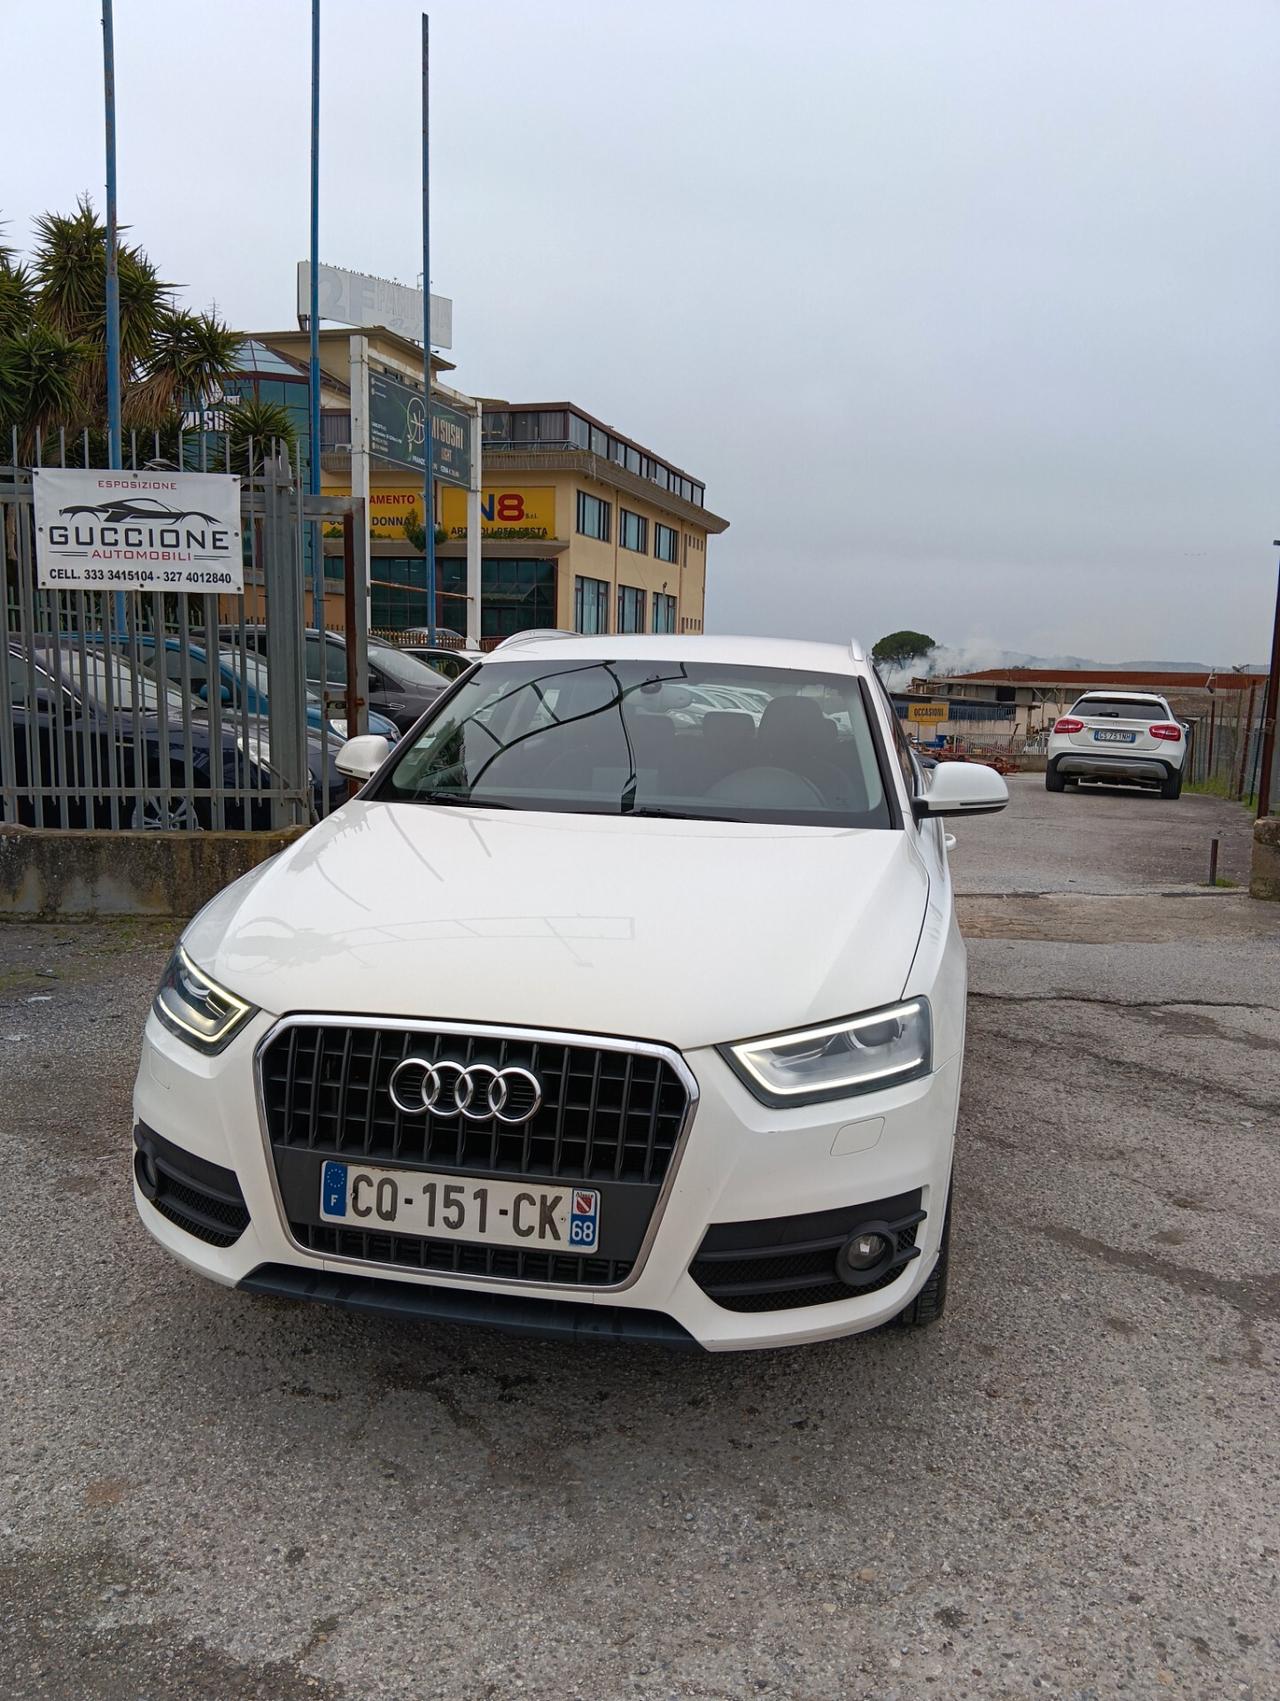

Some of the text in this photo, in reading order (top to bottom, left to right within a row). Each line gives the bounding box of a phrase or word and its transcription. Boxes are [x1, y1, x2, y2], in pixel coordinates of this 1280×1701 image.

[98, 480, 177, 491] ESPOSIZIONE
[49, 525, 229, 550] GUCCIONE
[92, 550, 191, 561] AUTOMOBILI
[49, 568, 81, 580] CELL.
[84, 569, 104, 580] 333
[108, 569, 154, 581] 3415104
[163, 571, 182, 582] 327
[186, 571, 232, 584] 4012840
[330, 1195, 339, 1207] F
[352, 1173, 563, 1241] CQ-151-CK
[571, 1220, 594, 1242] 68
